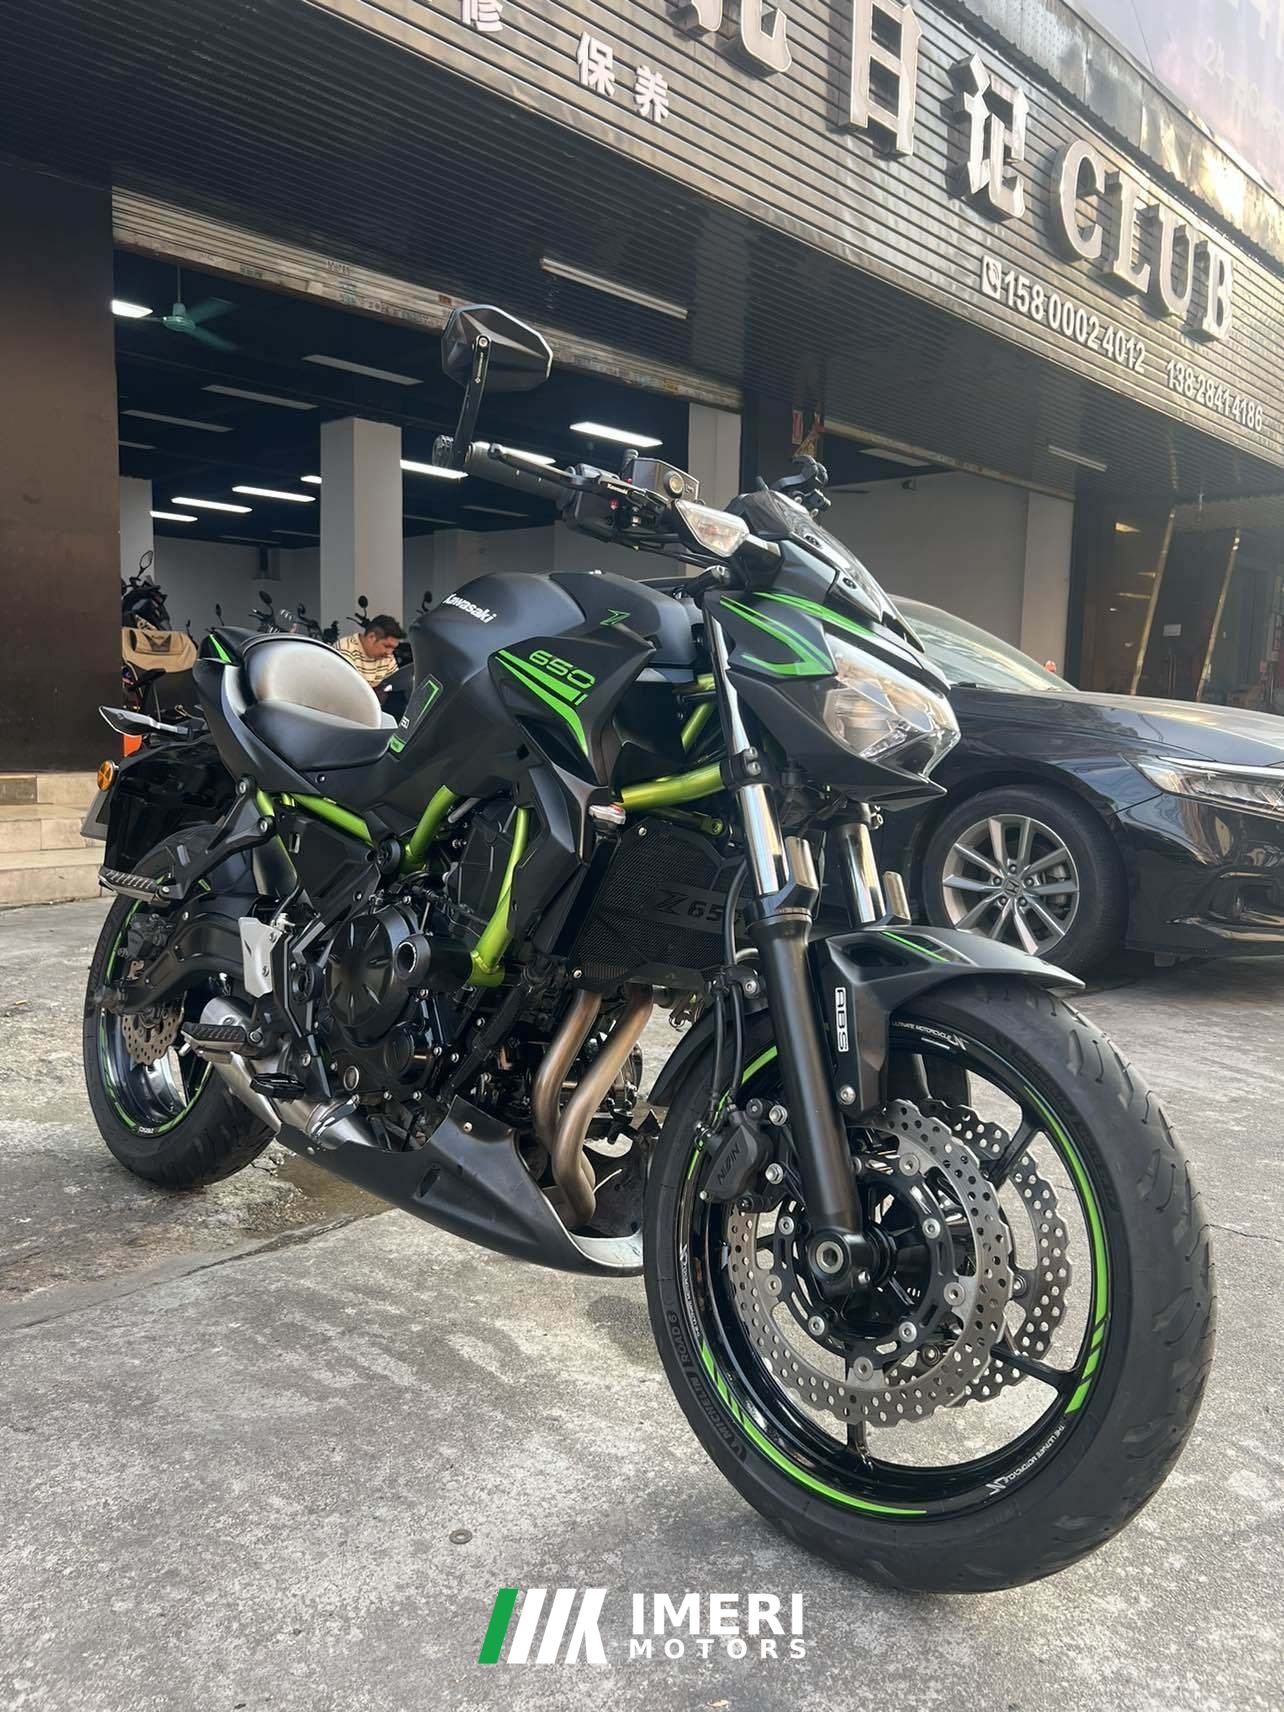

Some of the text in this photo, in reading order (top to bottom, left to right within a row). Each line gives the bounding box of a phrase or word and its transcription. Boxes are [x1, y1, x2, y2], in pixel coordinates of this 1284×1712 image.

[577, 32, 670, 123] 保养
[1059, 139, 1234, 341] CLUB
[442, 593, 497, 623] Kawasaki
[528, 650, 597, 690] 650
[835, 987, 849, 1052] ABS
[671, 1327, 690, 1364] ROAD
[690, 1376, 734, 1439] MICHELIN
